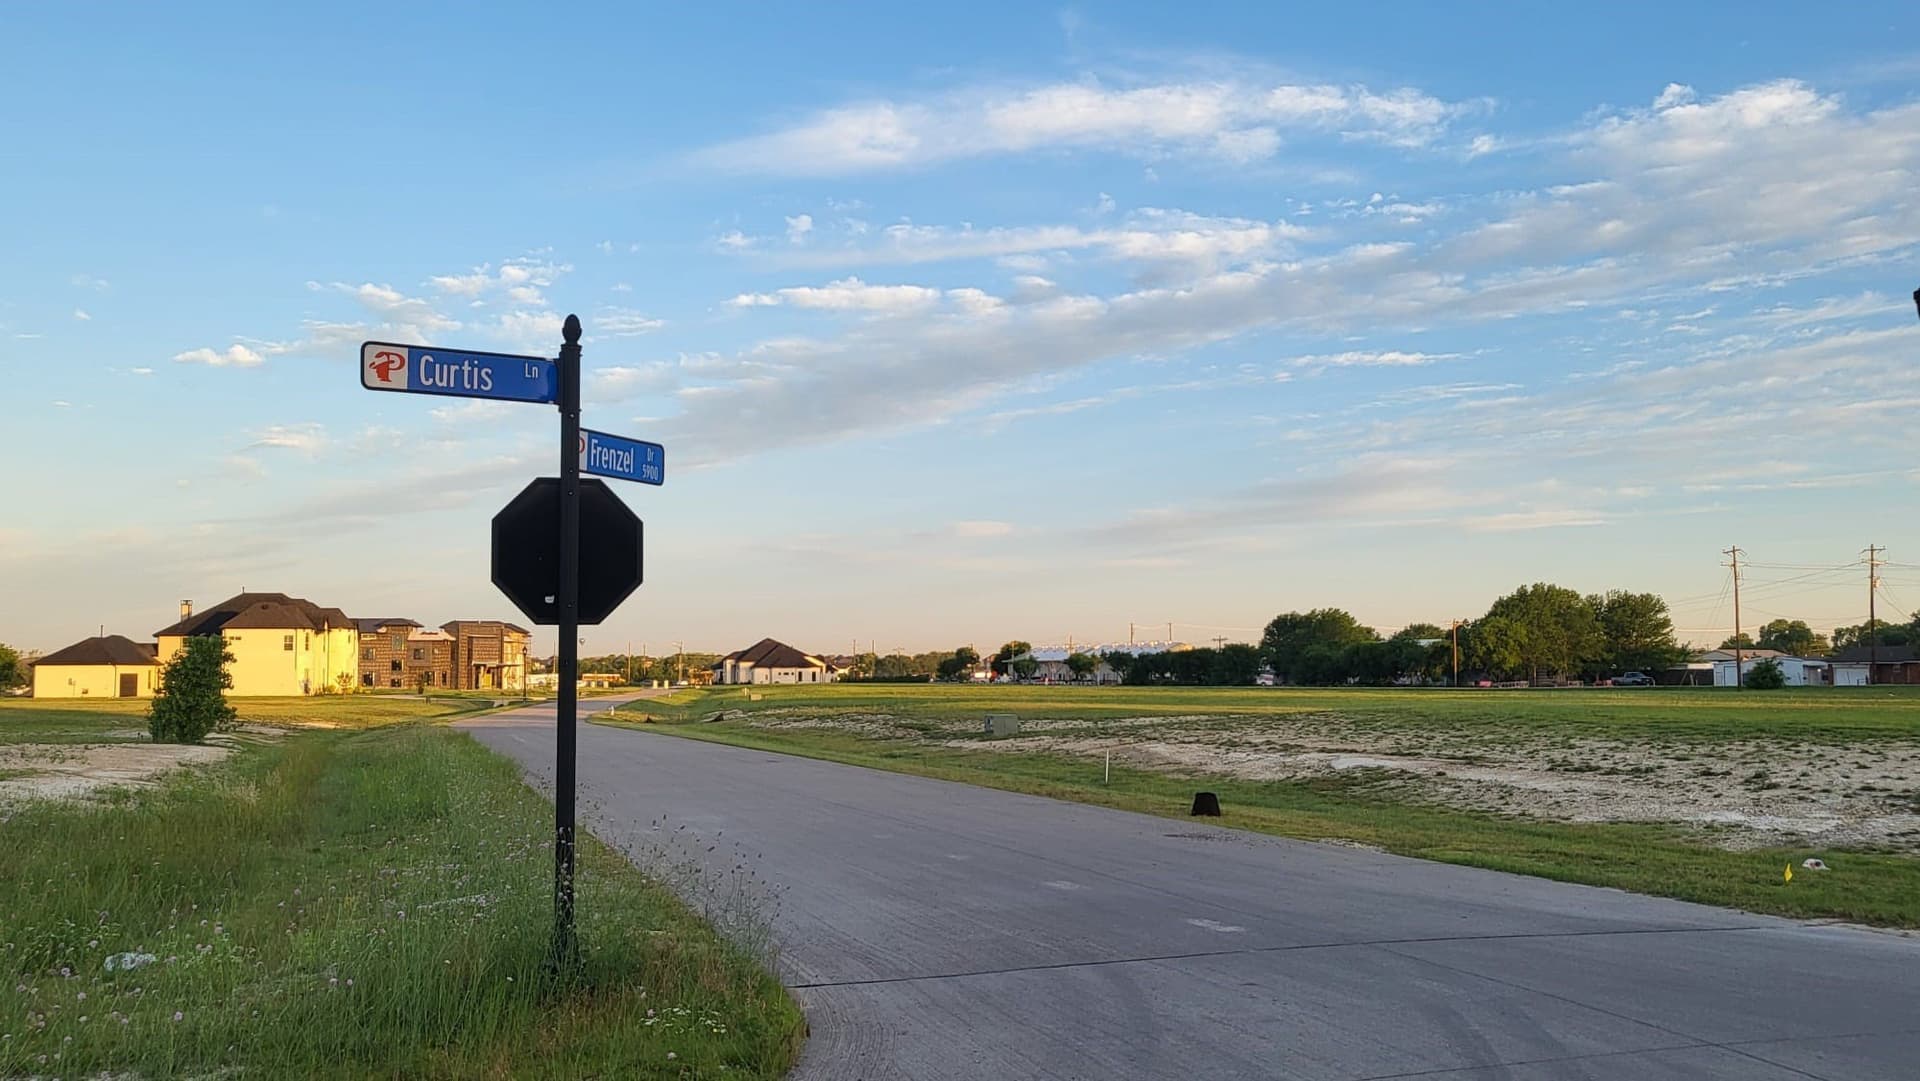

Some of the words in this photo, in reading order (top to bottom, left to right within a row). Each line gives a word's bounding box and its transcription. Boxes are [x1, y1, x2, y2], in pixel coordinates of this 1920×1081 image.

[419, 354, 493, 391] Curtis
[524, 362, 539, 379] Ln
[590, 438, 634, 474] Frenzel
[647, 447, 655, 462] Dr
[642, 464, 659, 481] 5900
